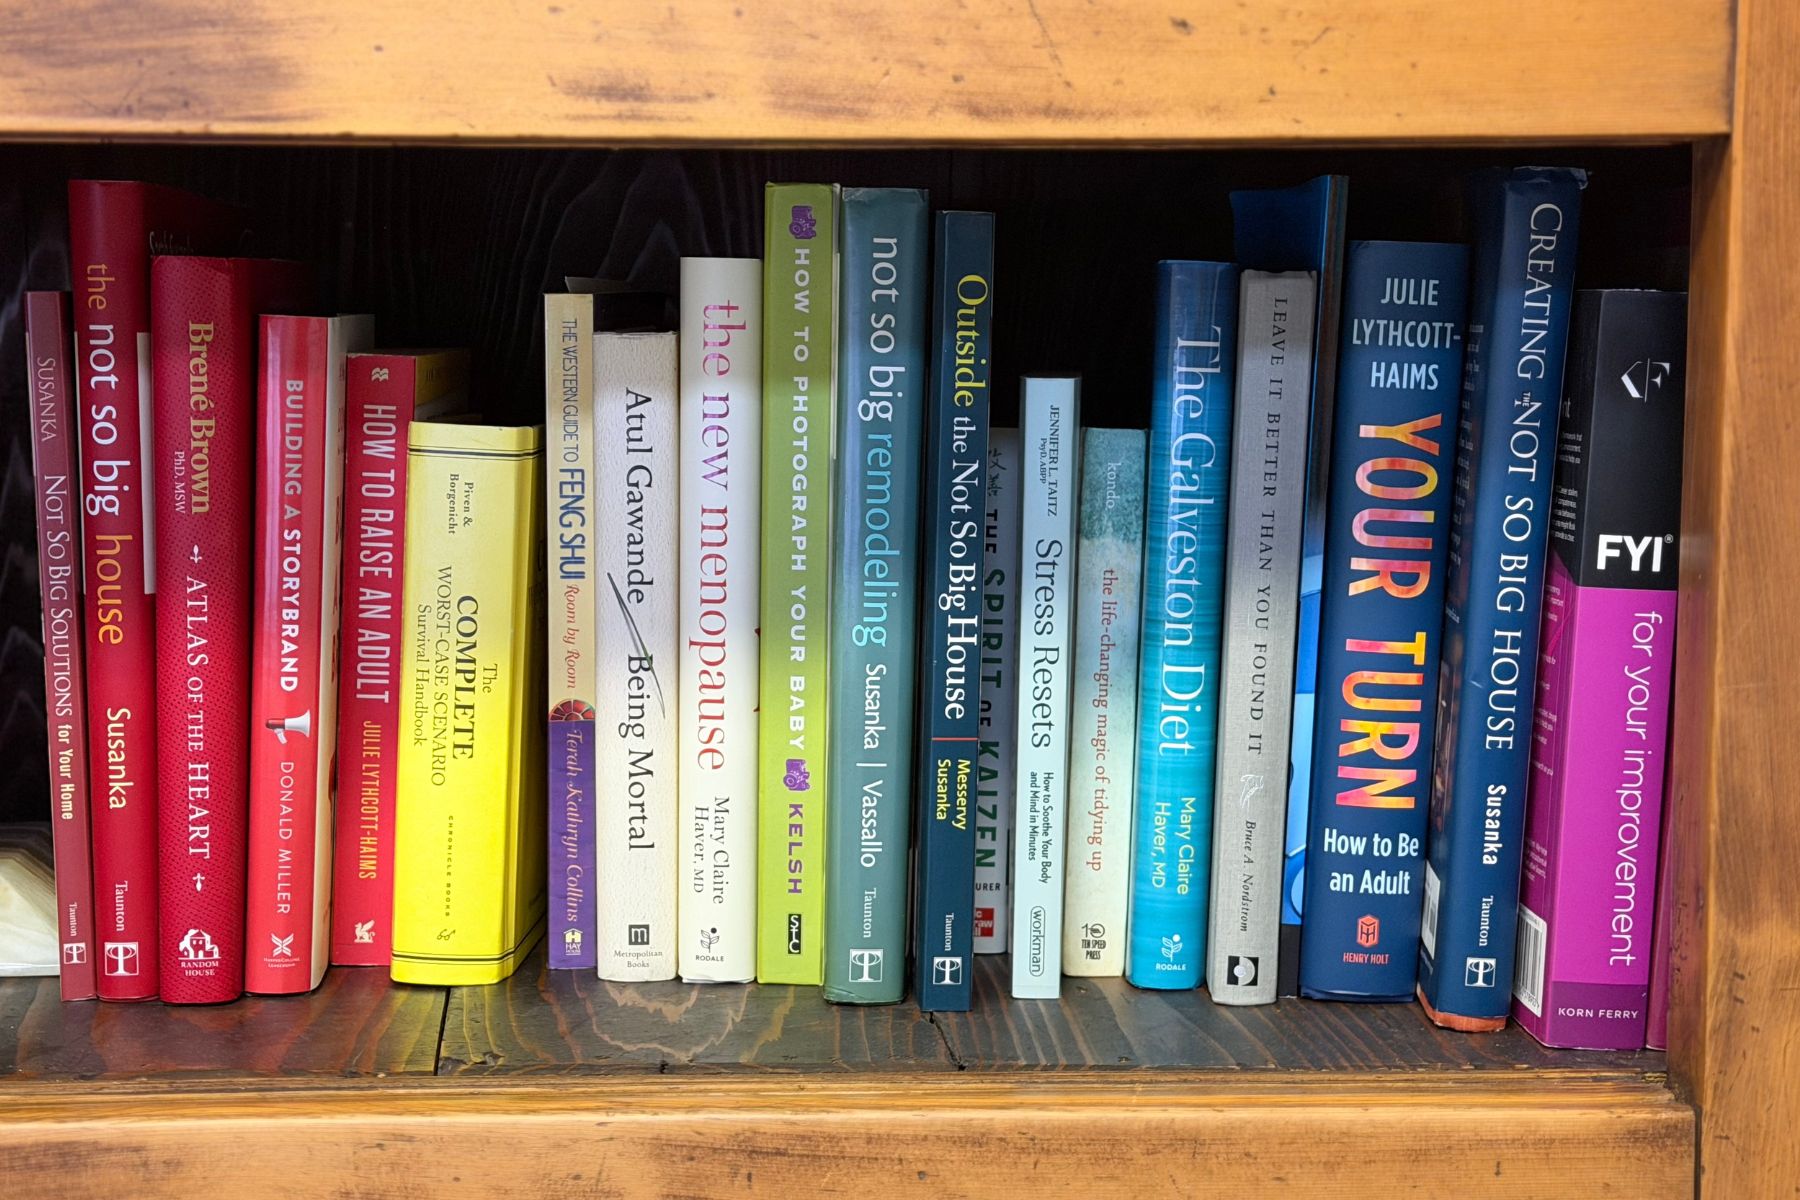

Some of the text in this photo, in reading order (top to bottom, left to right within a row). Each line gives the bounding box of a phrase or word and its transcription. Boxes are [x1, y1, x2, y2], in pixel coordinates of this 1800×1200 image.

[1352, 319, 1461, 349] LYTHCOTT-
[1381, 278, 1440, 306] JULIE
[37, 357, 56, 442] SUSANKA
[189, 321, 215, 514] Brené Brown
[1371, 362, 1438, 390] HAIMS
[86, 264, 133, 645] the not so big house
[174, 451, 185, 513] PhD, MSW
[464, 481, 475, 512] Piven
[559, 318, 585, 580] THE WESTERN GUIDE TO FENG SHUI
[626, 387, 654, 604] Atul Gawande
[852, 237, 905, 647] not so big remodeling
[938, 274, 988, 719] Outside the Not So Big House
[1048, 405, 1060, 516] JENNIFER TAITZ
[1485, 203, 1563, 750] CREATING NOT SO BIG HOUSE
[281, 380, 303, 692] BUILDING A STORYBRAND
[356, 405, 397, 704] HOW TO RAISE AN ADULT
[448, 473, 460, 535] Borgenicht
[689, 300, 747, 770] the new menopause
[788, 249, 810, 751] HOW TO PHOTOGRAPH YOUR BABY
[1159, 326, 1222, 757] The Galveston Diet
[1248, 297, 1288, 755] LEAVE IT BETTER THAN YOU FOUND IT
[44, 475, 74, 820] NOT SO BIG SOLUTIONS for Your Home
[562, 585, 580, 689] Room by Room
[982, 569, 1005, 688] SPIRIT
[1031, 538, 1063, 748] Stress Resets
[1336, 414, 1442, 808] YOUR TURN
[186, 576, 211, 860] ATLAS OF THE HEART
[413, 604, 431, 746] Survival Handbook
[431, 566, 452, 786] WORST-CASE SCENARIO
[453, 595, 479, 760] COMPLETE
[483, 663, 499, 693] The
[1086, 569, 1118, 872] the life-changing magic of tidying up
[107, 708, 134, 810] Susanka
[358, 721, 381, 880] JULIE LYTHCOTT-HAIMS
[618, 654, 655, 852] Being Mortal
[860, 664, 887, 868] Susanka Vassallo
[936, 759, 950, 820] Susanka
[952, 759, 971, 830] Messervy
[1609, 610, 1662, 966] for your improvement
[277, 762, 294, 915] DONALD MILLER
[561, 730, 584, 922] Terah Kathryn Collins
[694, 807, 709, 893] Haver, MD
[710, 797, 730, 905] Mary Claire
[787, 804, 804, 894] KELSH
[1028, 771, 1040, 861] and Mind Minutes
[1038, 772, 1054, 883] How Soothe Your Body
[1152, 802, 1171, 888] Haver, MD
[1174, 797, 1196, 895] Mary Claire
[1324, 828, 1419, 857] How to Be
[1482, 784, 1506, 865] Susanka
[1240, 820, 1256, 932] Bruce Nordstrom
[1330, 870, 1410, 895] an Adult
[614, 949, 662, 959] Metropolitan
[627, 960, 649, 968] Books
[1032, 910, 1042, 973] workman
[1155, 963, 1186, 971] RODALE
[1343, 952, 1389, 965] HENRY HOLT
[1558, 1007, 1638, 1019] KORN FERRY
